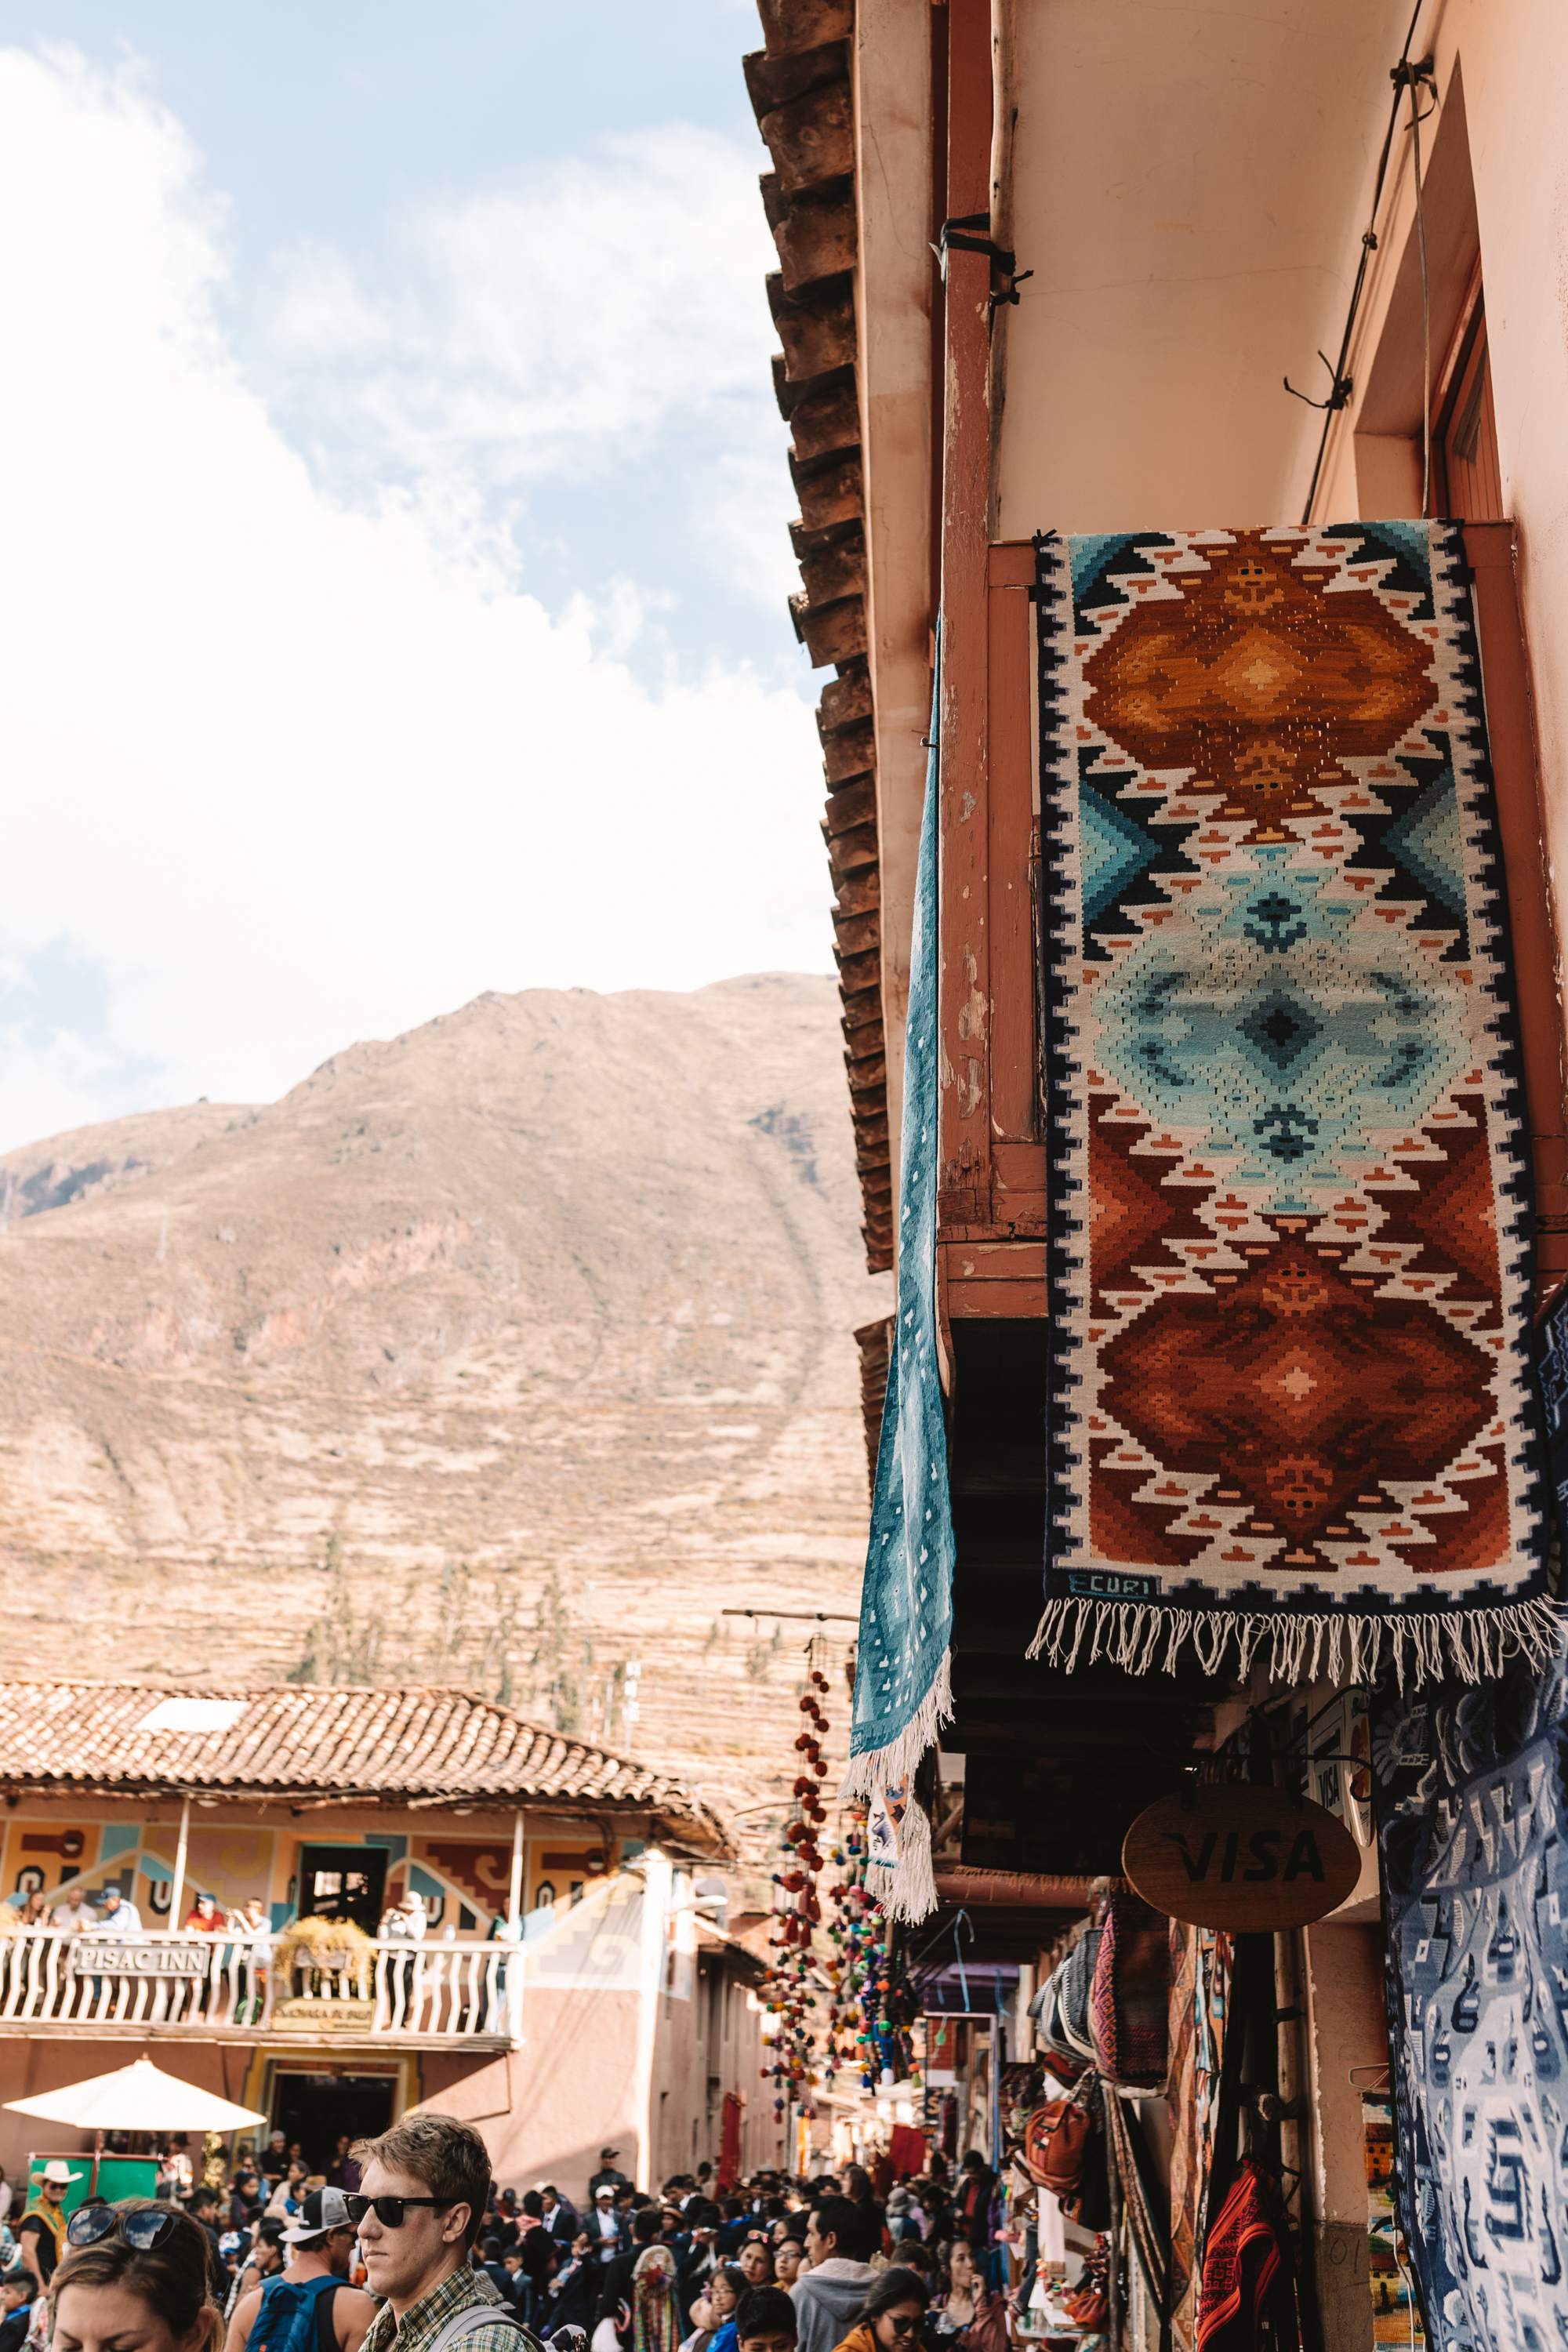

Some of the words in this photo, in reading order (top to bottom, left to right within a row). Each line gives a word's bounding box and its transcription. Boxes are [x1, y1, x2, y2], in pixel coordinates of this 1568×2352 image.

[1069, 1573, 1149, 1595] ECURI
[1317, 1762, 1341, 1809] VISA
[1160, 1829, 1327, 1882] VISA
[80, 1948, 153, 1970] PISAC
[159, 1950, 205, 1971] INN
